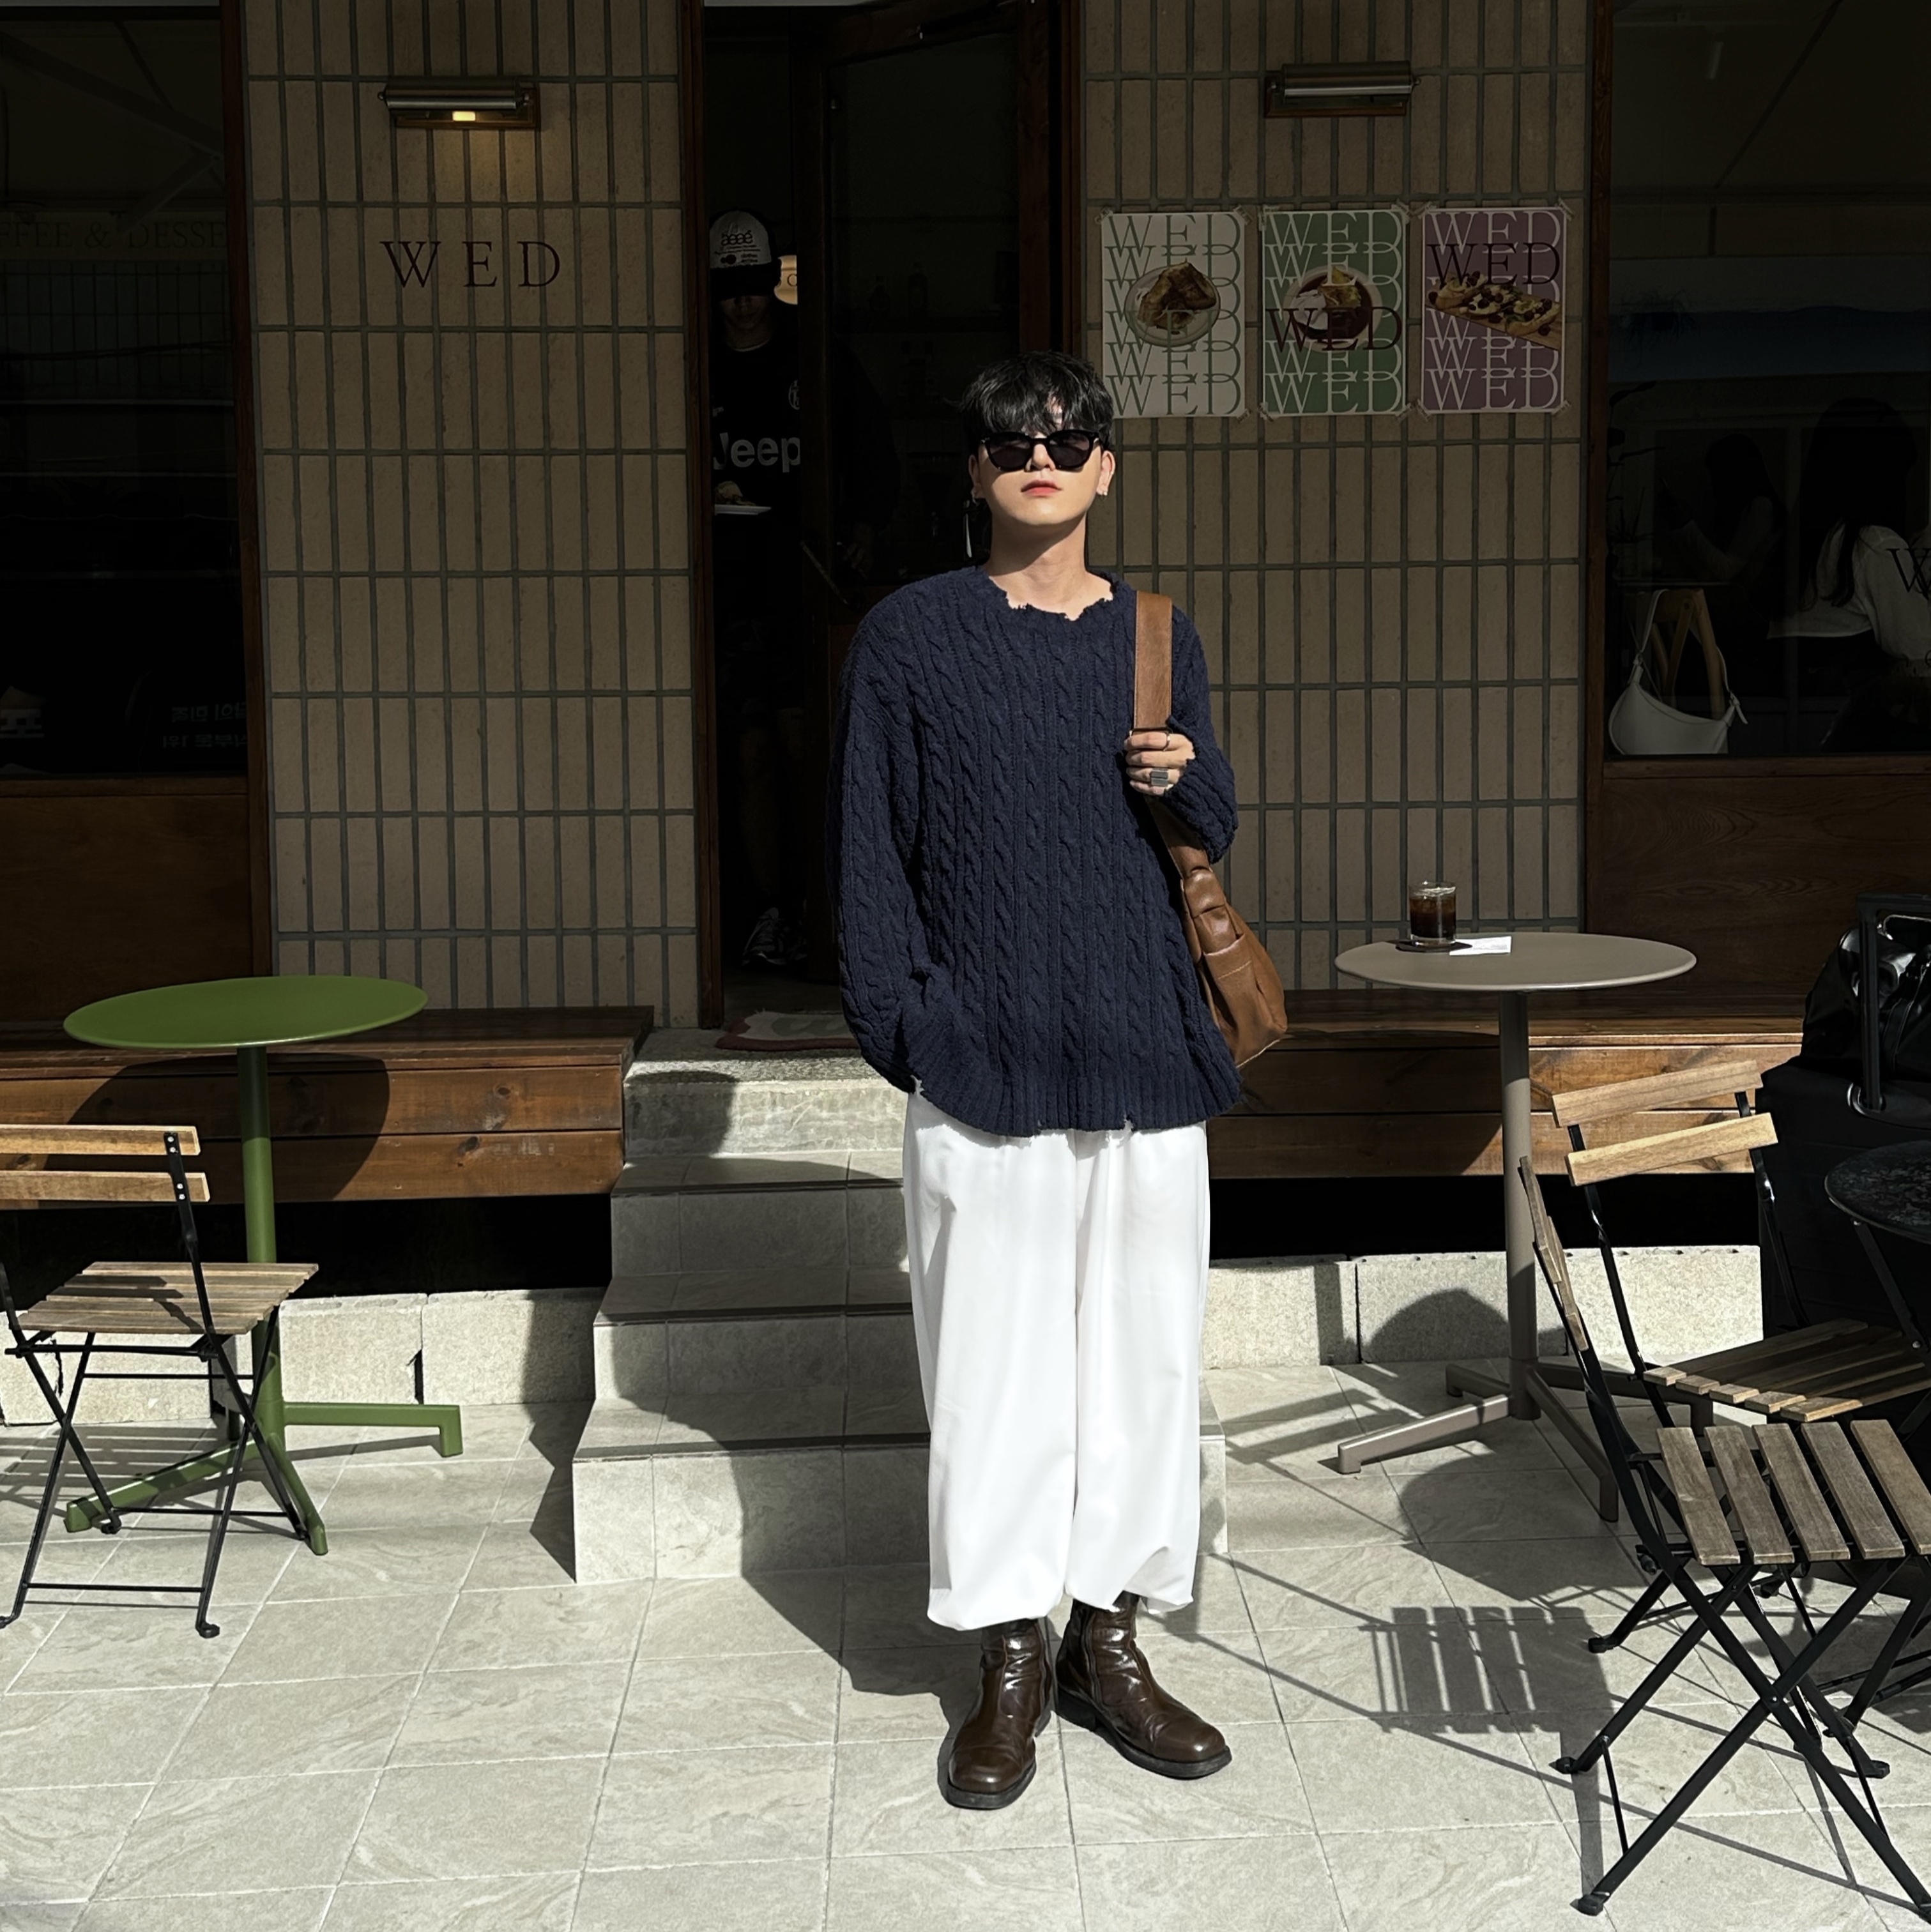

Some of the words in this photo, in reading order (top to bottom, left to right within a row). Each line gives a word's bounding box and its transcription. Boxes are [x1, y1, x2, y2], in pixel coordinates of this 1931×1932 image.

[1108, 214, 1240, 257] WED
[1268, 212, 1401, 255] WED
[1425, 211, 1561, 254] WED
[1264, 242, 1401, 287] WED
[1426, 243, 1560, 289] WED
[1264, 307, 1402, 352] WED
[1106, 373, 1240, 416] WED
[1264, 371, 1401, 414] WED
[1425, 368, 1559, 410] WED
[713, 432, 800, 473] Jeep
